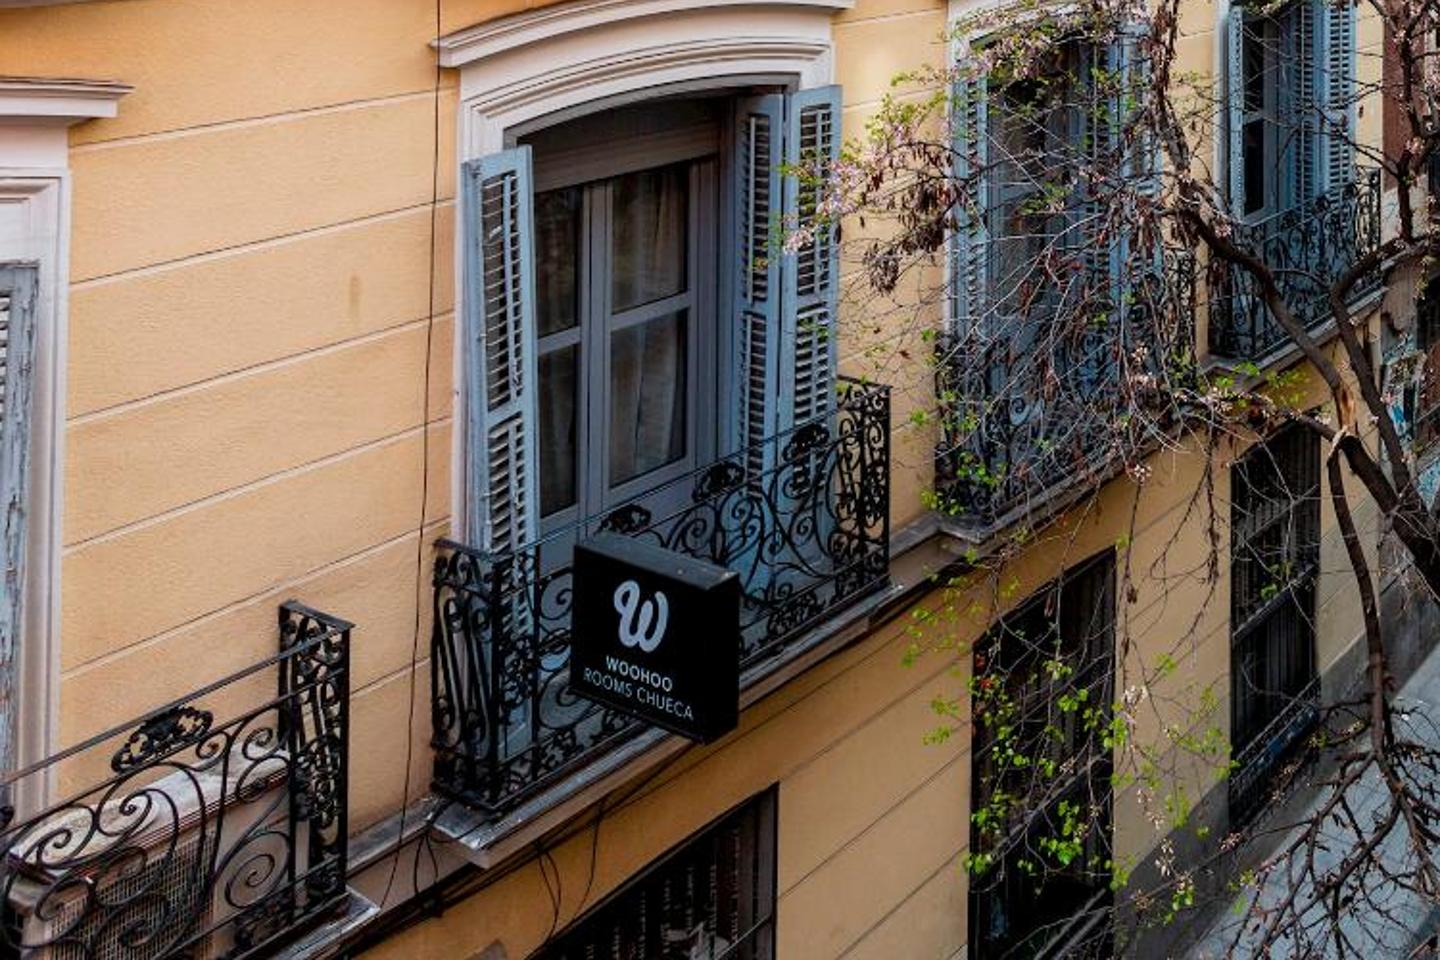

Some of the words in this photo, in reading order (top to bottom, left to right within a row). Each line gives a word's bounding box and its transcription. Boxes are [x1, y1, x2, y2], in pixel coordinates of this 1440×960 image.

[584, 668, 633, 698] ROOMS
[636, 686, 694, 721] CHUECA
[606, 656, 673, 692] WOOHOO
